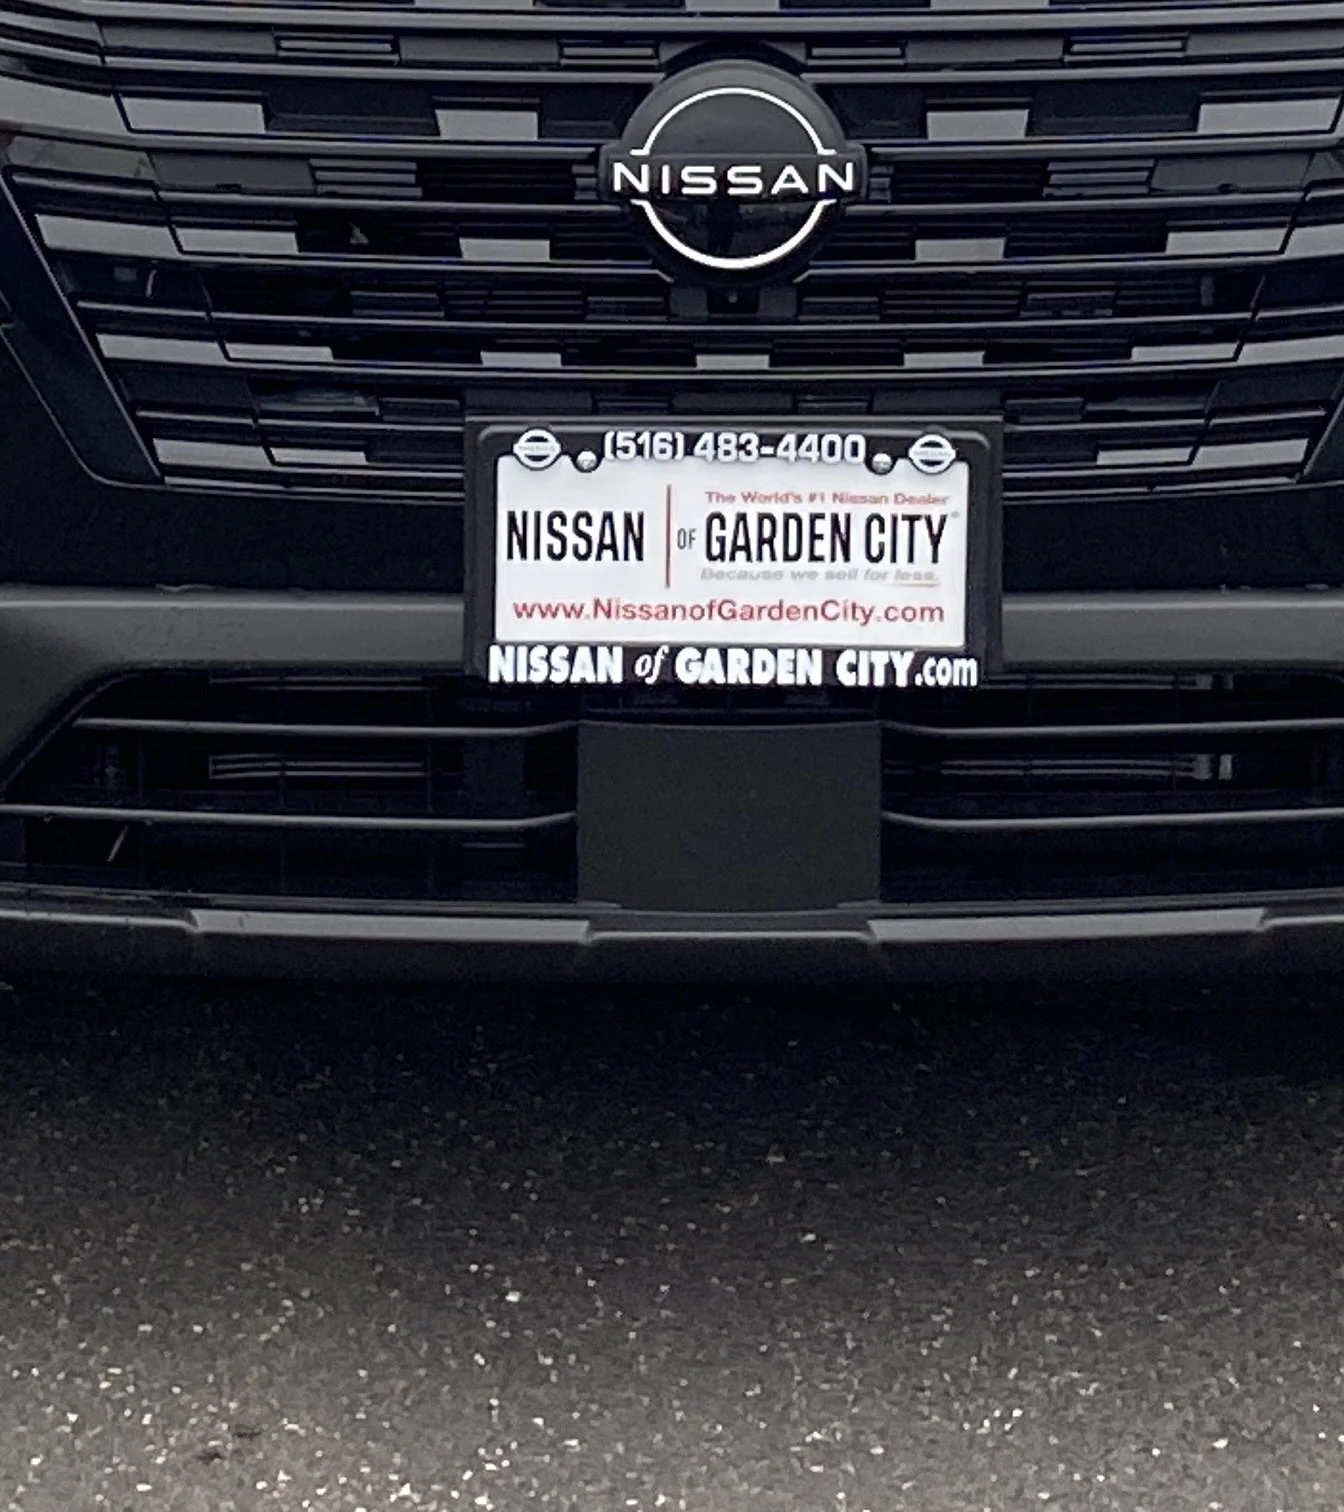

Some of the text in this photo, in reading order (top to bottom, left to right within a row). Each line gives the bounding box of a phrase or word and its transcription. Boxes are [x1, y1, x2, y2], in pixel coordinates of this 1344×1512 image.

[613, 162, 854, 195] NISSAN
[604, 431, 866, 464] (516) 483-4400
[705, 491, 950, 506] The World's #1 Nissan Dealer
[506, 510, 948, 565] NISSAN OF GARDEN CITY
[700, 567, 784, 581] Because
[790, 569, 819, 581] we
[824, 568, 858, 581] sell
[863, 568, 889, 581] for
[512, 597, 945, 626] www.NissanofGardenCity.com
[488, 644, 979, 687] NISSAN of GARDEN CITY.com
